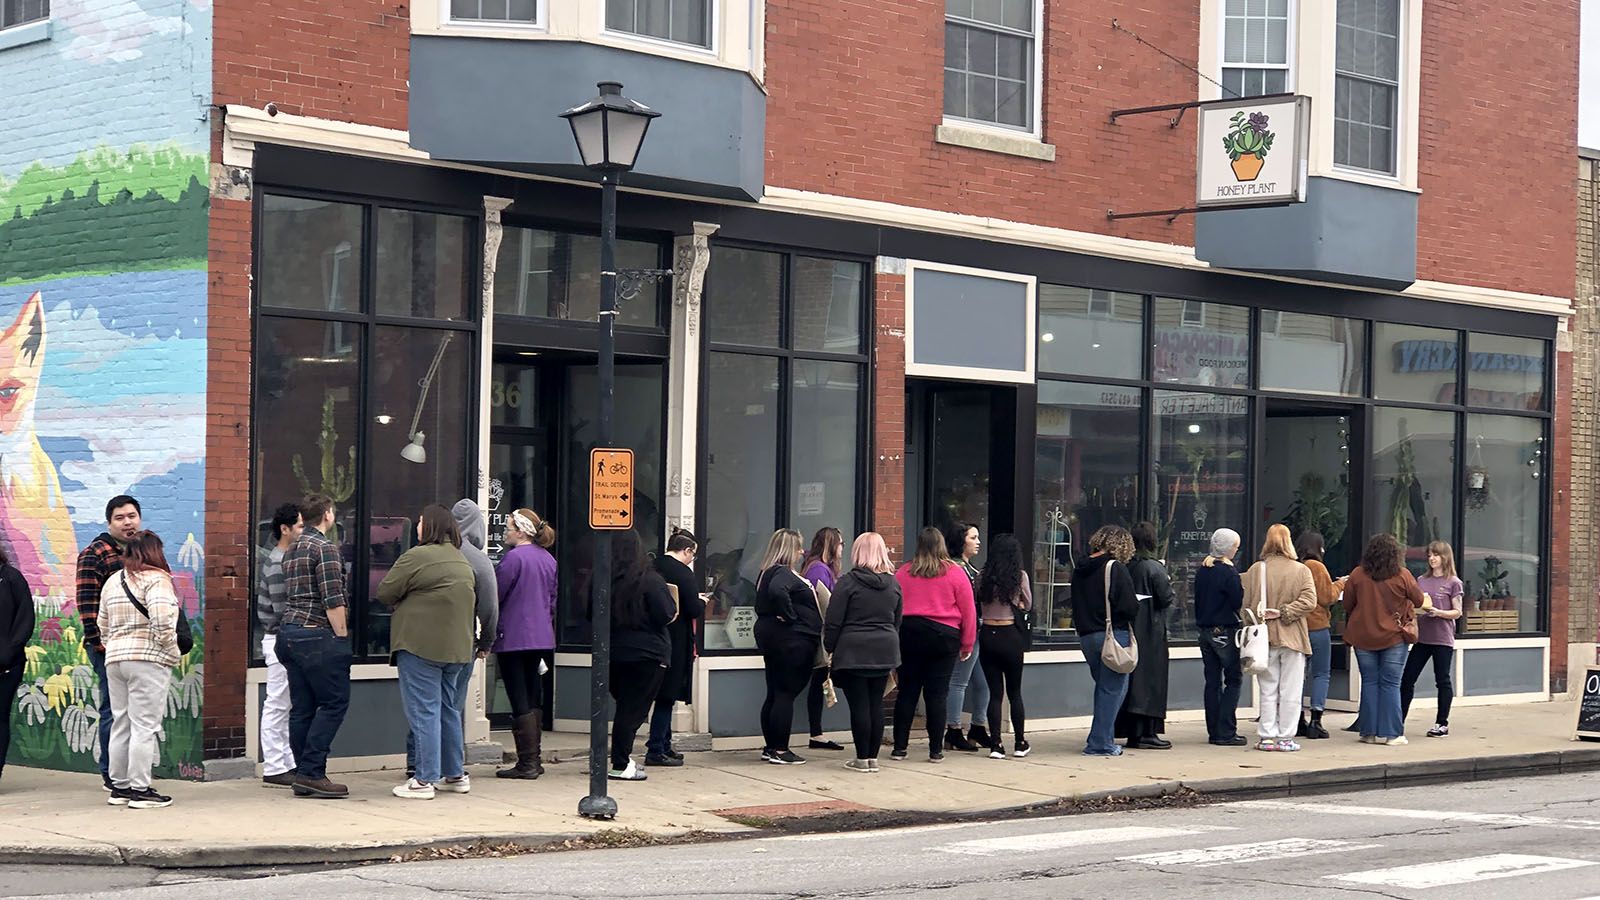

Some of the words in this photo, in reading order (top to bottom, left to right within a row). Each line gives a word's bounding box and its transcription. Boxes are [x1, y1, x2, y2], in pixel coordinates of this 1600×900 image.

[1217, 184, 1248, 196] HONEY
[1248, 182, 1276, 194] PLANT
[493, 513, 510, 525] PLA
